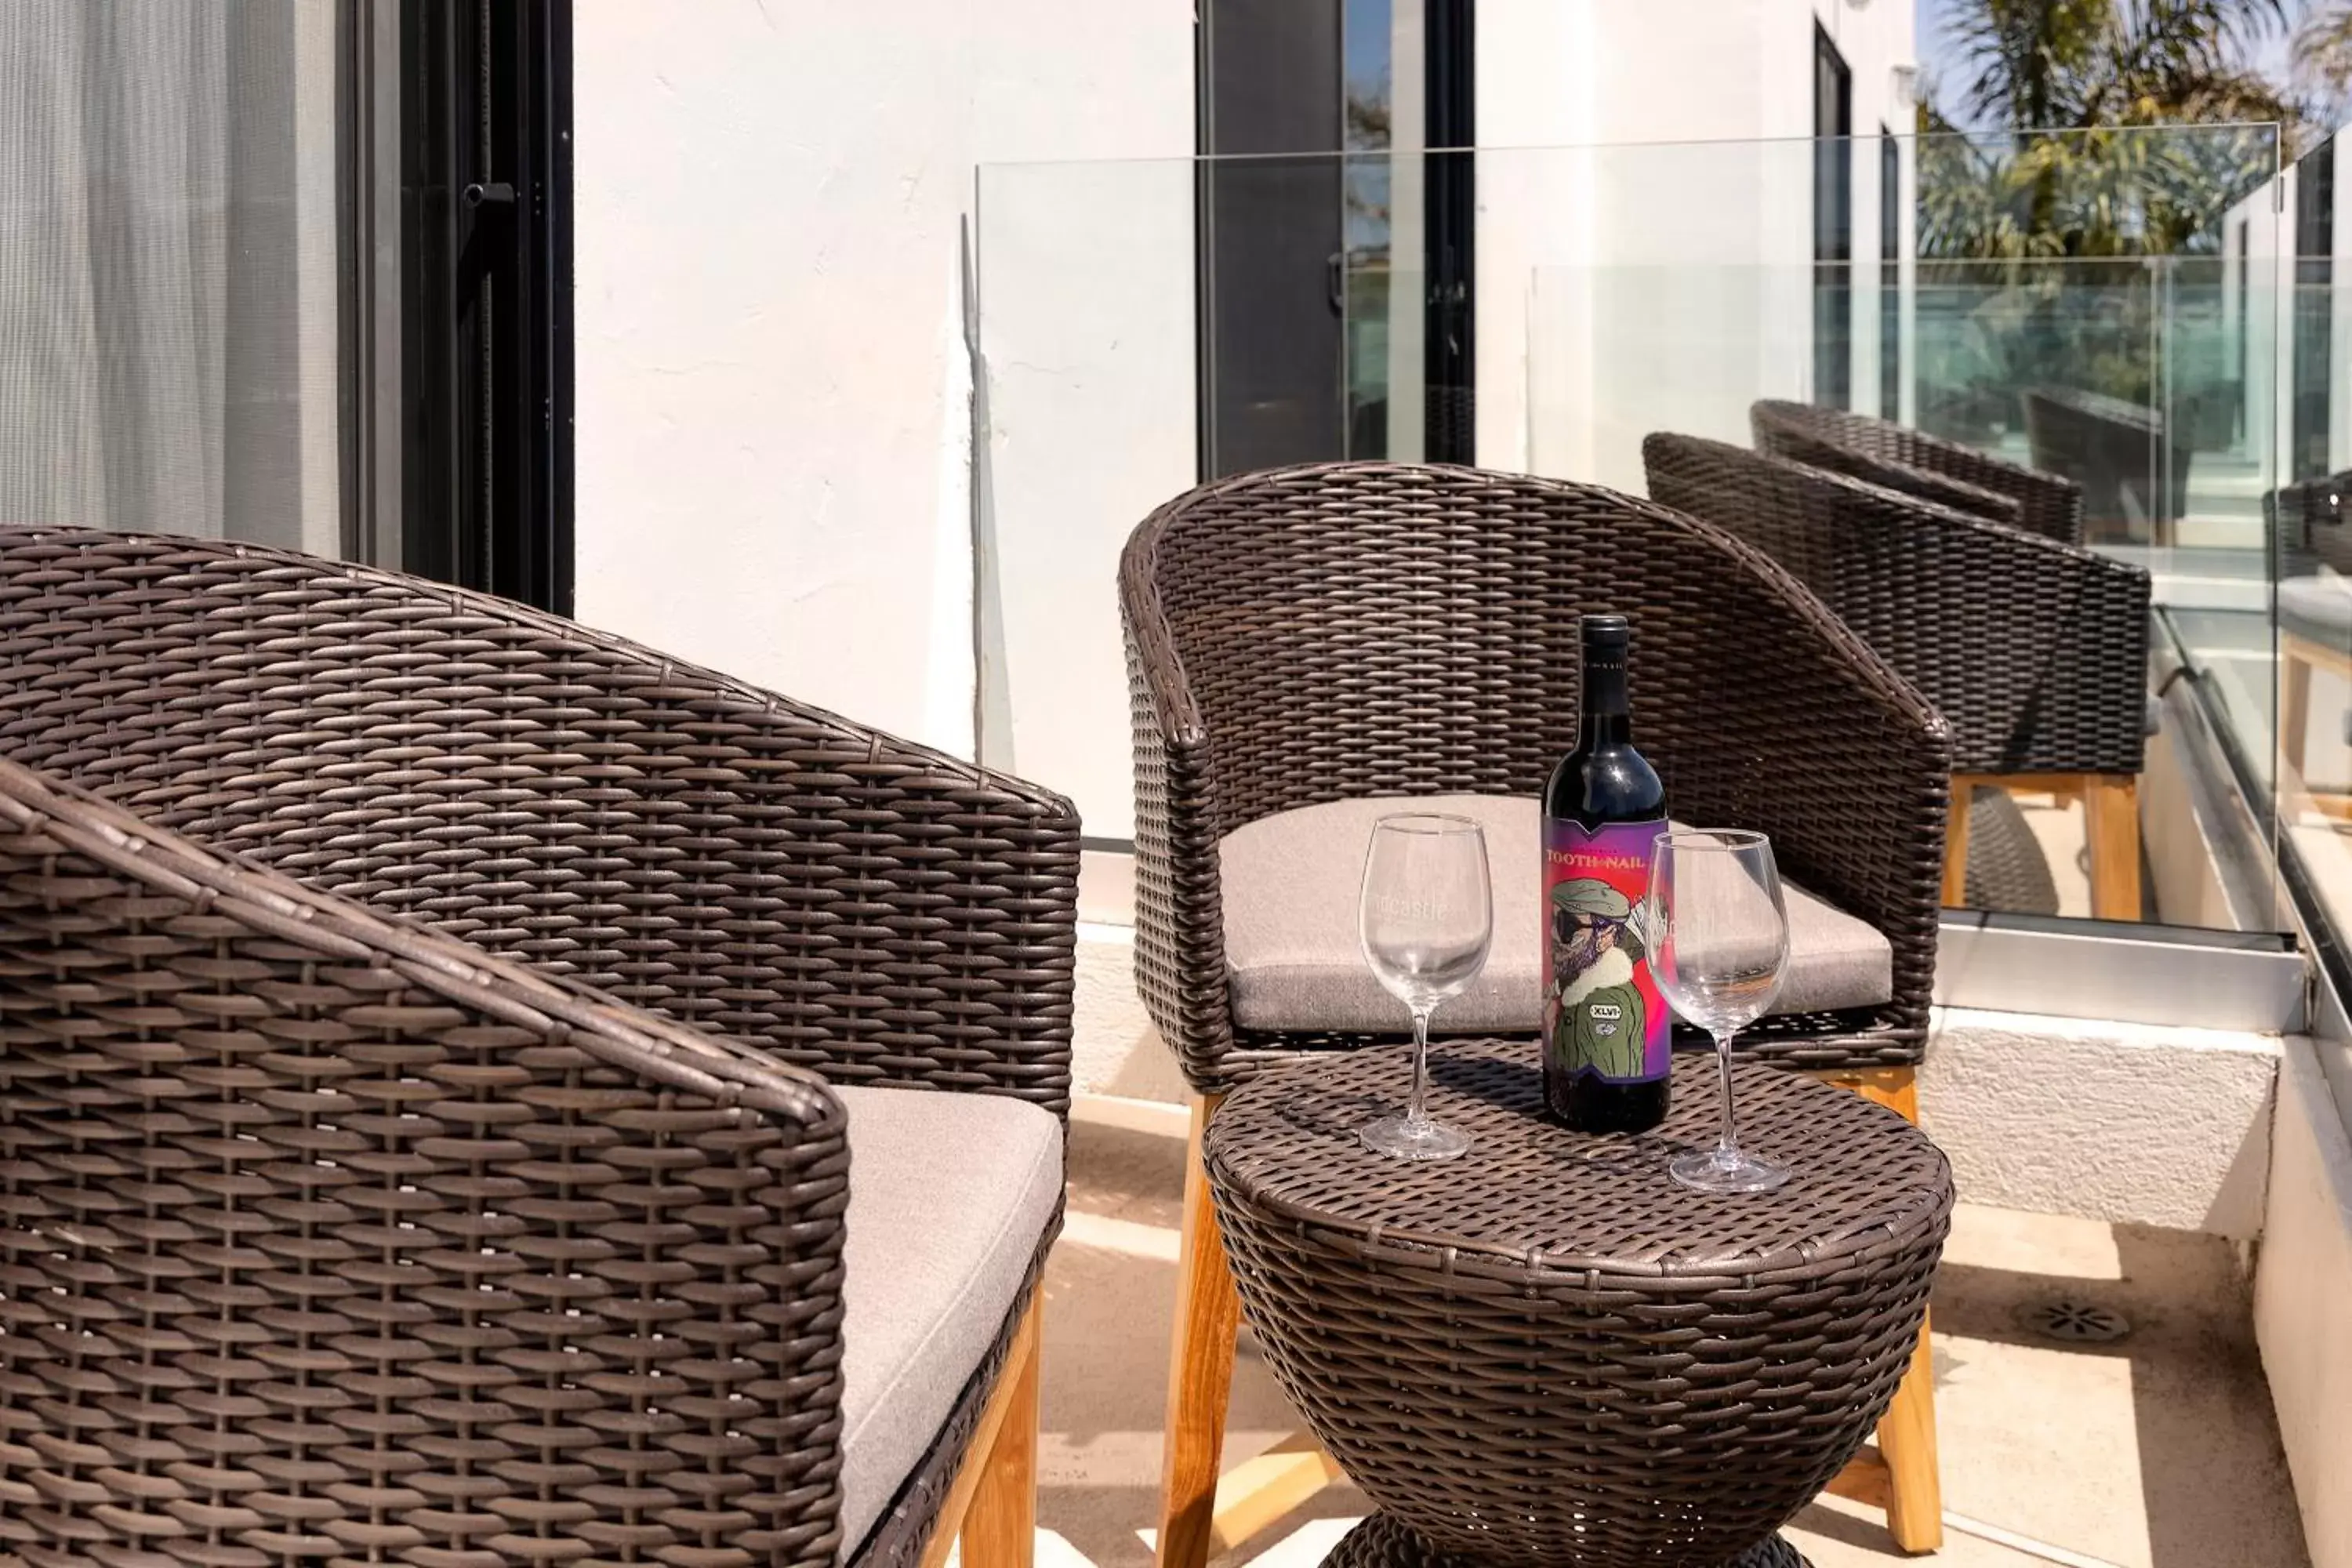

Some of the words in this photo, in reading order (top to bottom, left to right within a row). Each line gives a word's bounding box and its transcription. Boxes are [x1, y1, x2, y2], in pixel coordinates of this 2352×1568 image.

[1545, 848, 1598, 868] TOOTH
[1606, 855, 1646, 869] NAIL
[1594, 1007, 1617, 1016] XLVI
